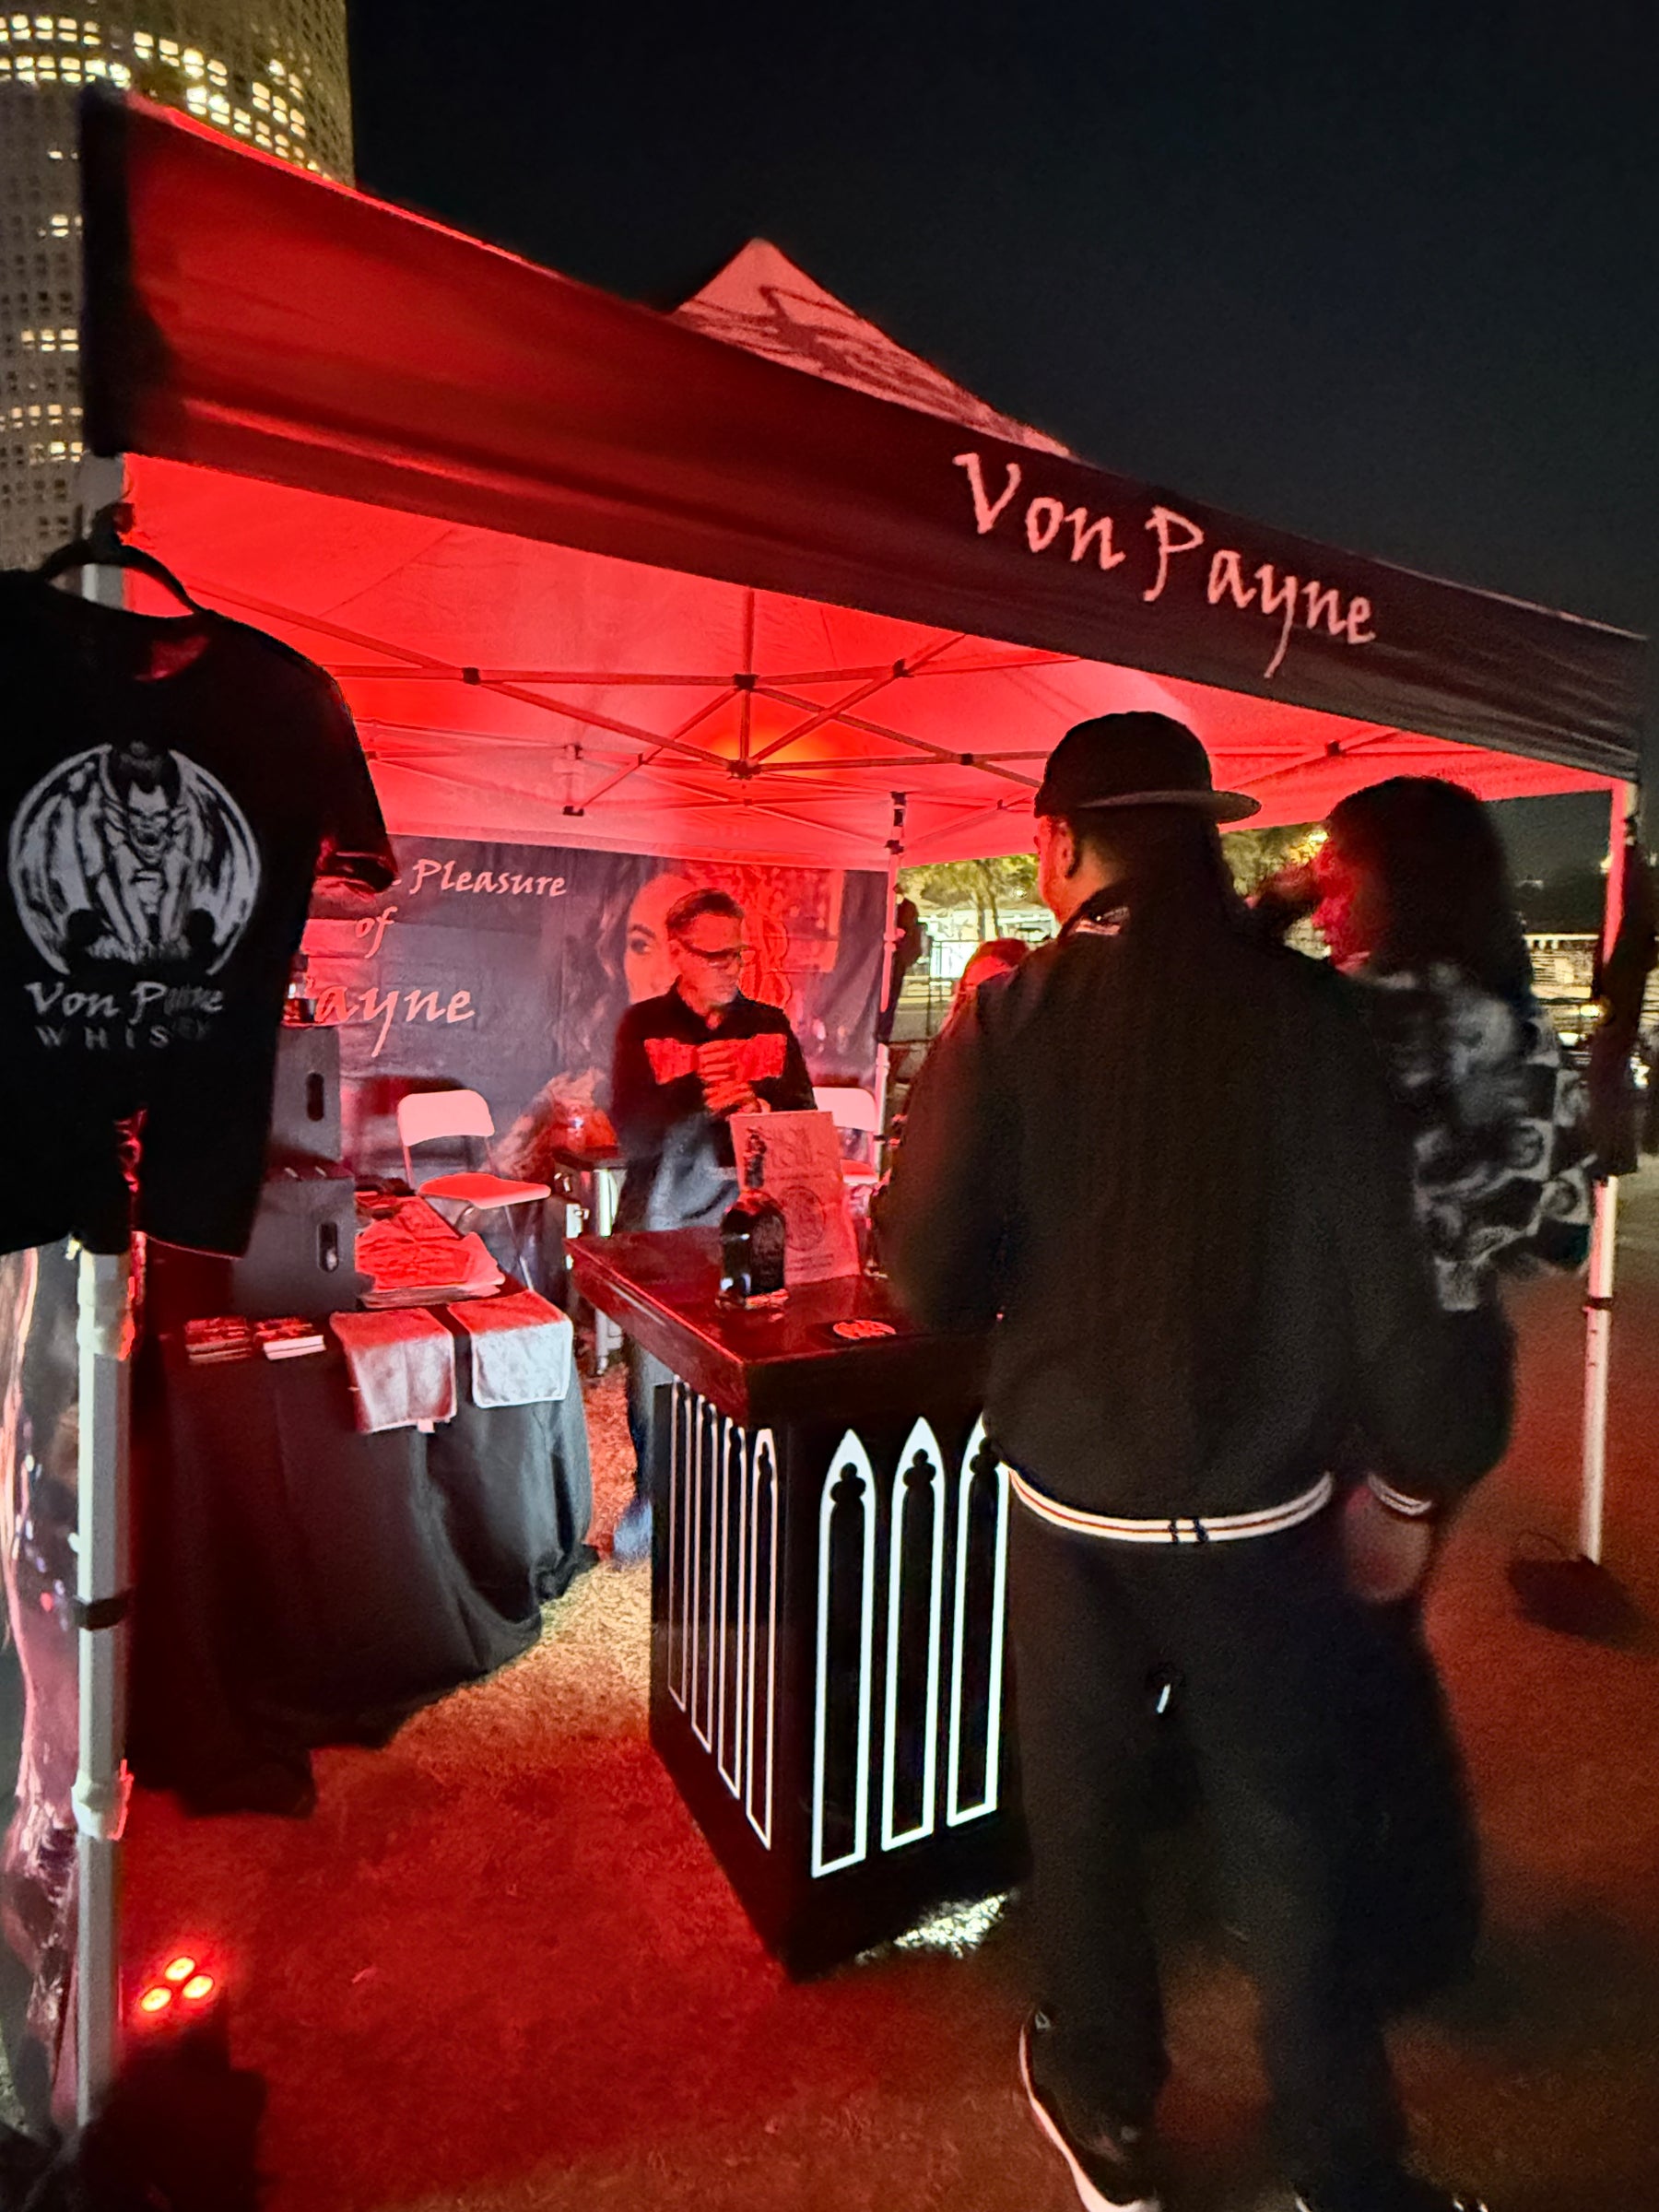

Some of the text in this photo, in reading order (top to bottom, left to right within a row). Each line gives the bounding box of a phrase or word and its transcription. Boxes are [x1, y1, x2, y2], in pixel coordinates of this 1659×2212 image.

[953, 452, 1377, 680] Von Payne
[409, 858, 567, 898] Pleasure
[355, 906, 398, 959] of
[23, 980, 225, 1027] Von Pne
[313, 984, 477, 1058] ayne
